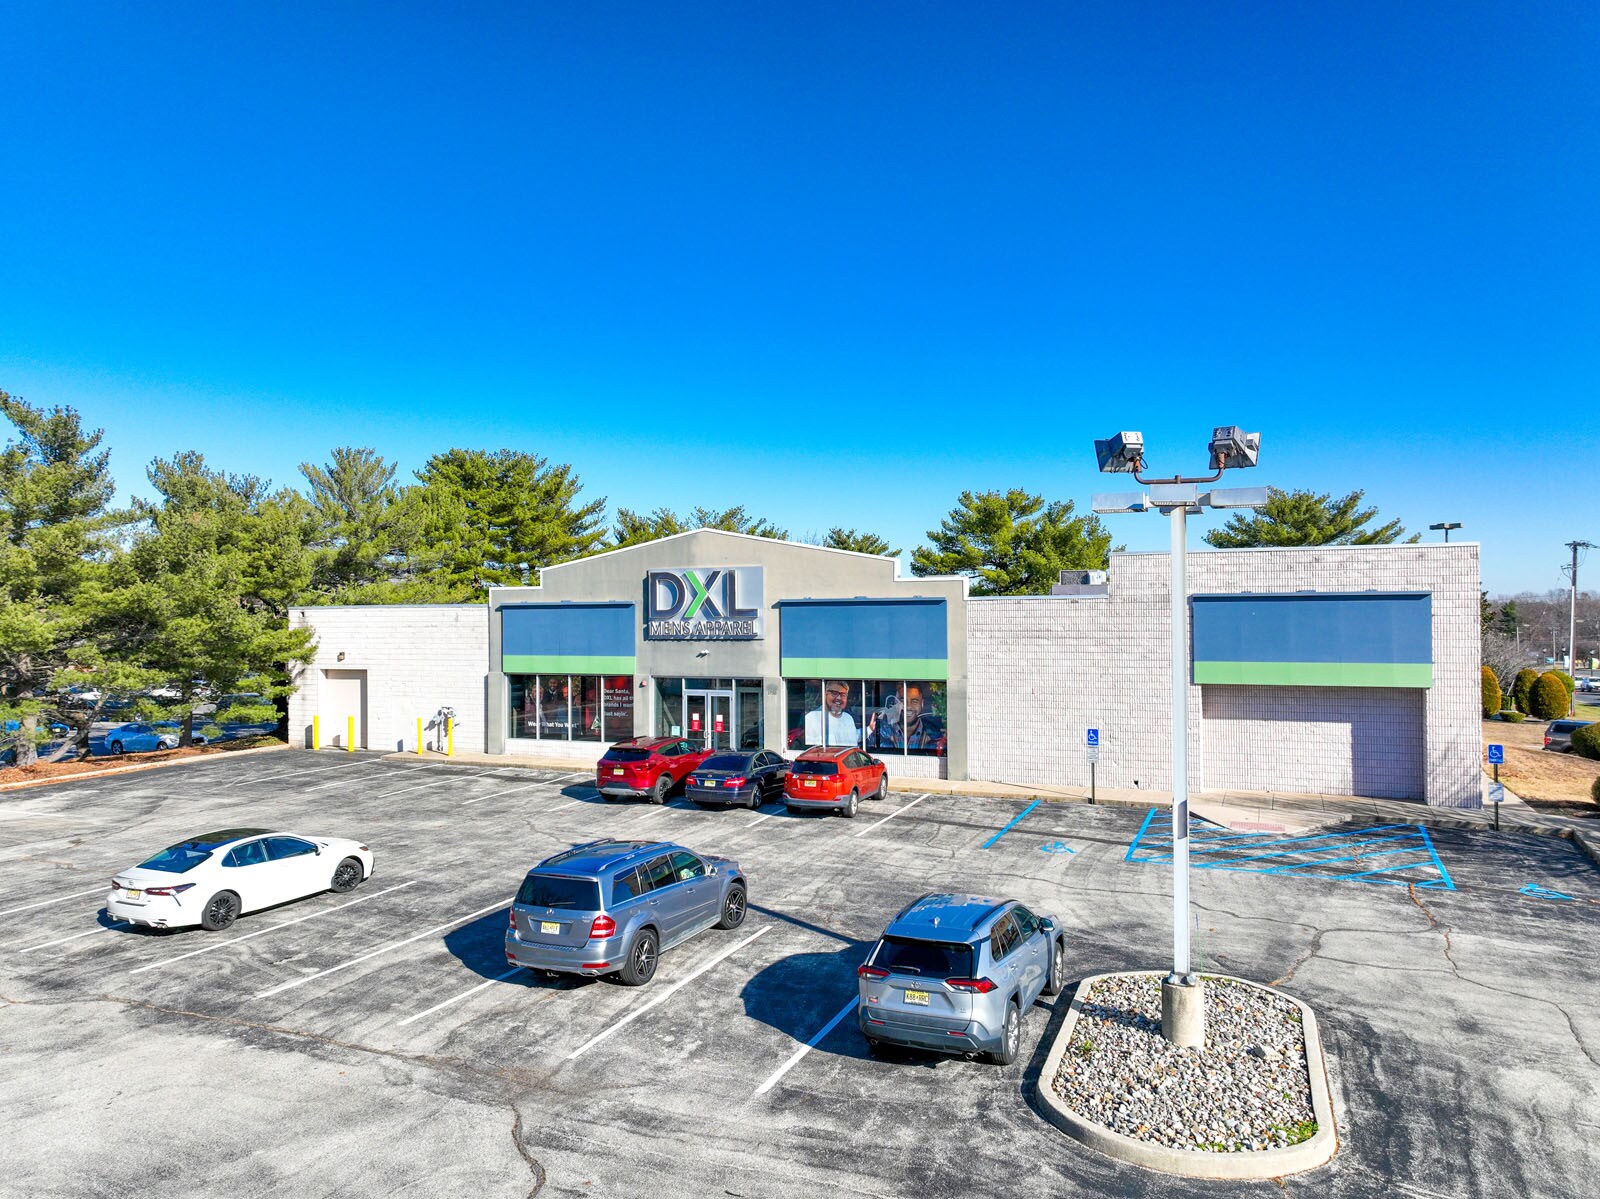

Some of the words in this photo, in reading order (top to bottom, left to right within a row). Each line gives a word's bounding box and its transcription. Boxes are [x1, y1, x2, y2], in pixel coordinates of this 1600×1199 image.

[649, 570, 758, 618] DXL
[649, 621, 691, 636] MENS
[694, 620, 758, 636] APPAREL
